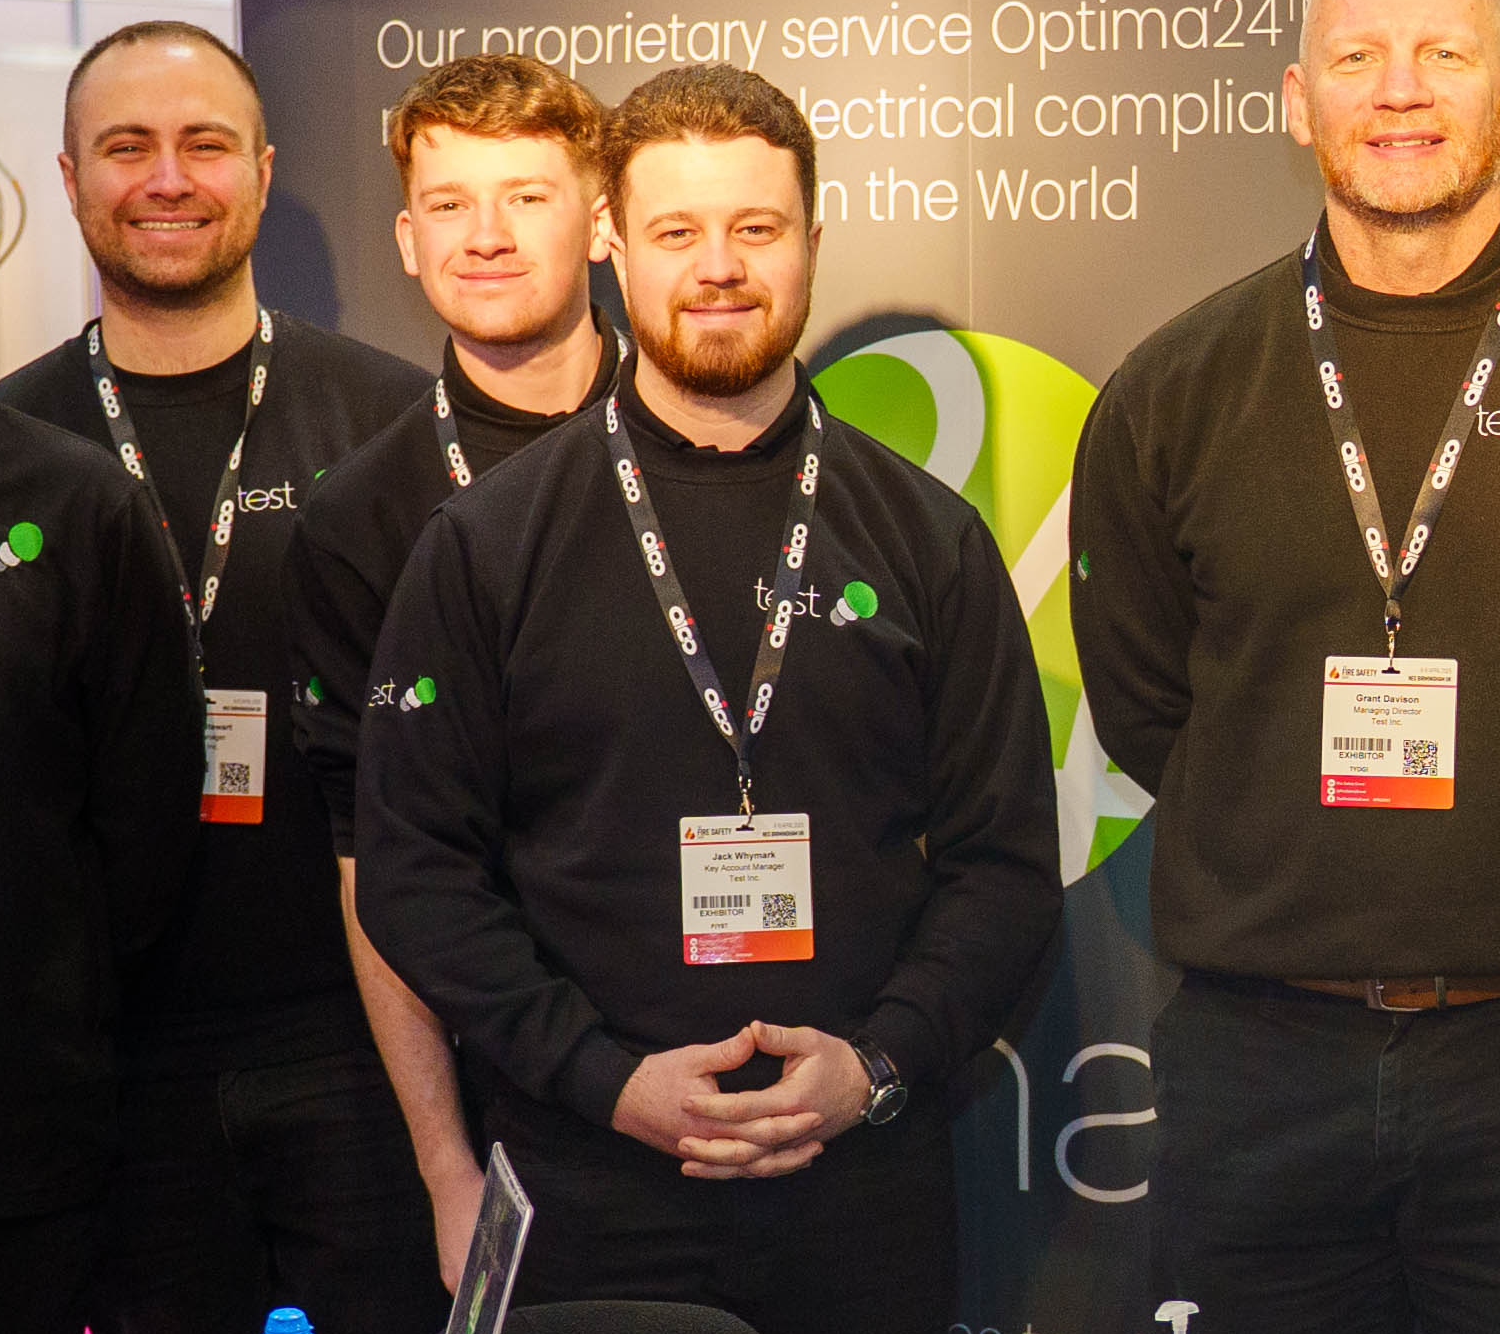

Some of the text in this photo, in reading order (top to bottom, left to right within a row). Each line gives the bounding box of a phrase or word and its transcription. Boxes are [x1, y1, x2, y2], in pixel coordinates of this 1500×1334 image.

[377, 19, 465, 69] Our
[481, 12, 768, 75] proprietary
[780, 2, 972, 60] service
[798, 83, 1015, 142] lectrical
[868, 165, 1139, 222] the World
[1319, 361, 1343, 409] aico
[1462, 357, 1494, 407] aico
[1341, 441, 1366, 493] aico
[1429, 438, 1461, 490] aico
[237, 481, 298, 513] test
[640, 531, 666, 577] aico
[783, 523, 808, 569] aico
[1365, 526, 1390, 579] aico
[1400, 524, 1429, 576] aico
[668, 605, 698, 656] aico
[766, 599, 794, 649] aico
[1355, 669, 1377, 677] SAFETY
[703, 688, 734, 737] aico
[747, 683, 773, 735] aico
[1353, 706, 1422, 716] Managing Director
[1355, 694, 1420, 704] Grant Davison
[1371, 718, 1388, 726] Test
[1339, 751, 1385, 760] EXHIBITOR
[704, 865, 719, 873] Key
[752, 863, 785, 872] Manager
[712, 851, 776, 861] Jack Whymark
[699, 909, 744, 917] EXHIBITOR
